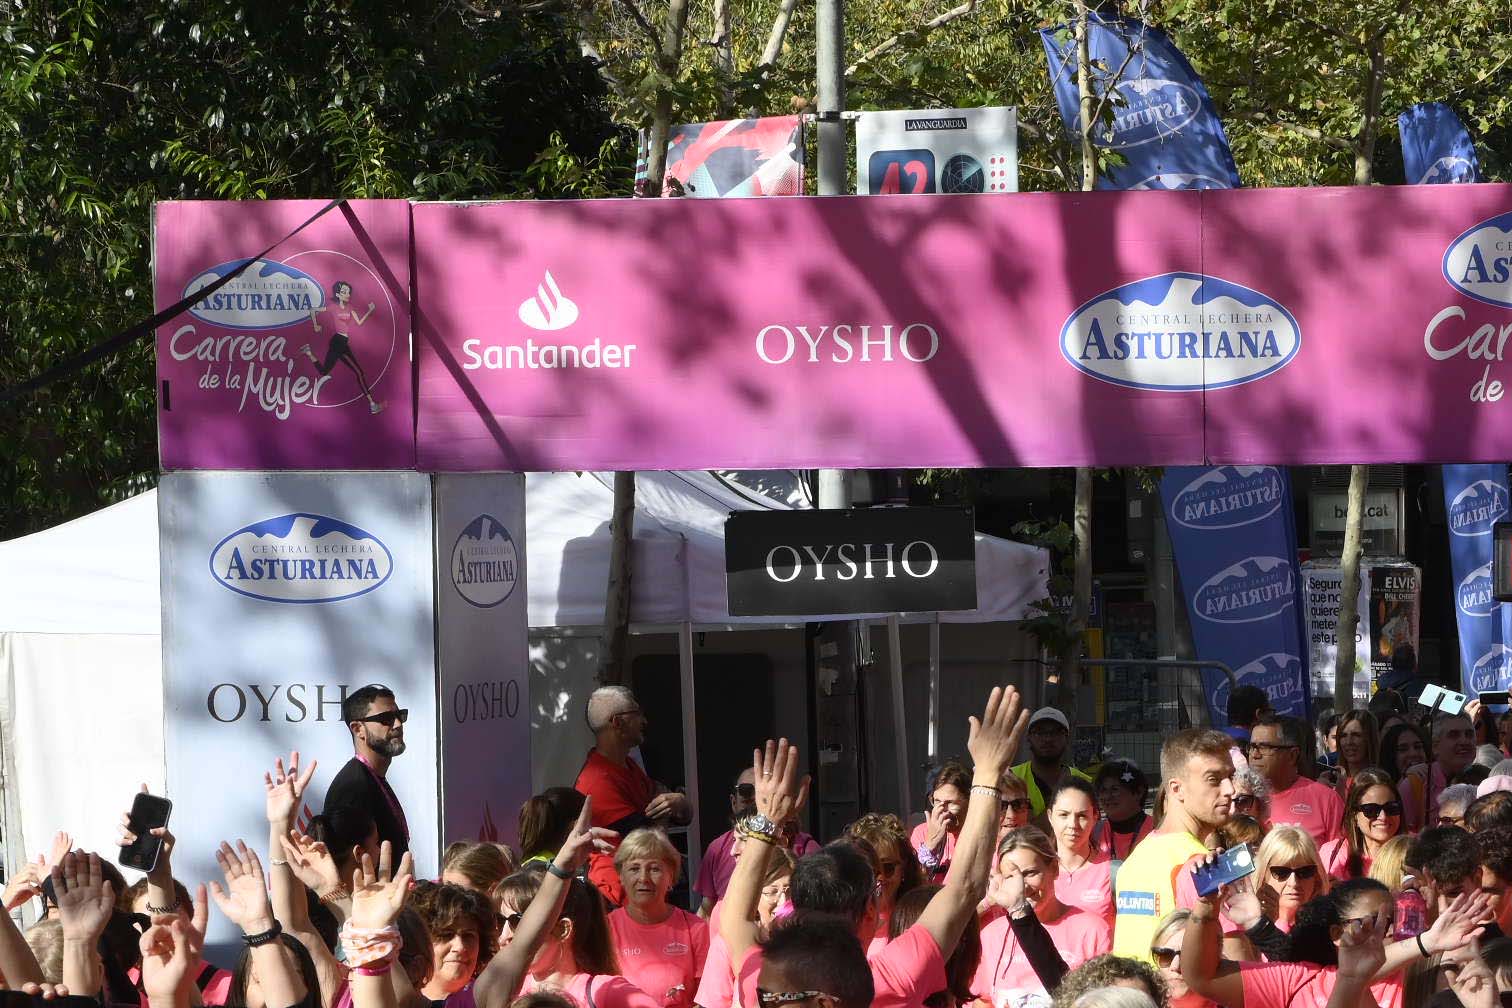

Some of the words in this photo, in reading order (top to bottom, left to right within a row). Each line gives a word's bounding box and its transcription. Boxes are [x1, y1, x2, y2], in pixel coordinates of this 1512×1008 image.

[1115, 313, 1192, 326] CENTRAL
[1199, 312, 1274, 324] LECHERA
[169, 324, 287, 362] Carrera
[462, 338, 636, 371] Santander
[755, 322, 940, 364] OYSHO
[1079, 317, 1282, 361] ASTURIANA
[199, 363, 221, 389] de
[225, 362, 240, 389] la
[238, 358, 332, 421] Mujer
[1469, 364, 1504, 402] de
[224, 546, 381, 580] ASTURIANA
[252, 545, 309, 553] CENTRAL
[316, 544, 374, 553] LECHERA
[766, 540, 939, 582] OYSHO
[456, 549, 515, 585] ASTURIANA
[1385, 576, 1416, 590] ELVIS
[1310, 592, 1327, 606] que
[1311, 606, 1341, 618] quiere
[1311, 619, 1337, 631] mete
[207, 683, 390, 723] OYSH
[454, 679, 520, 724] OYSHO
